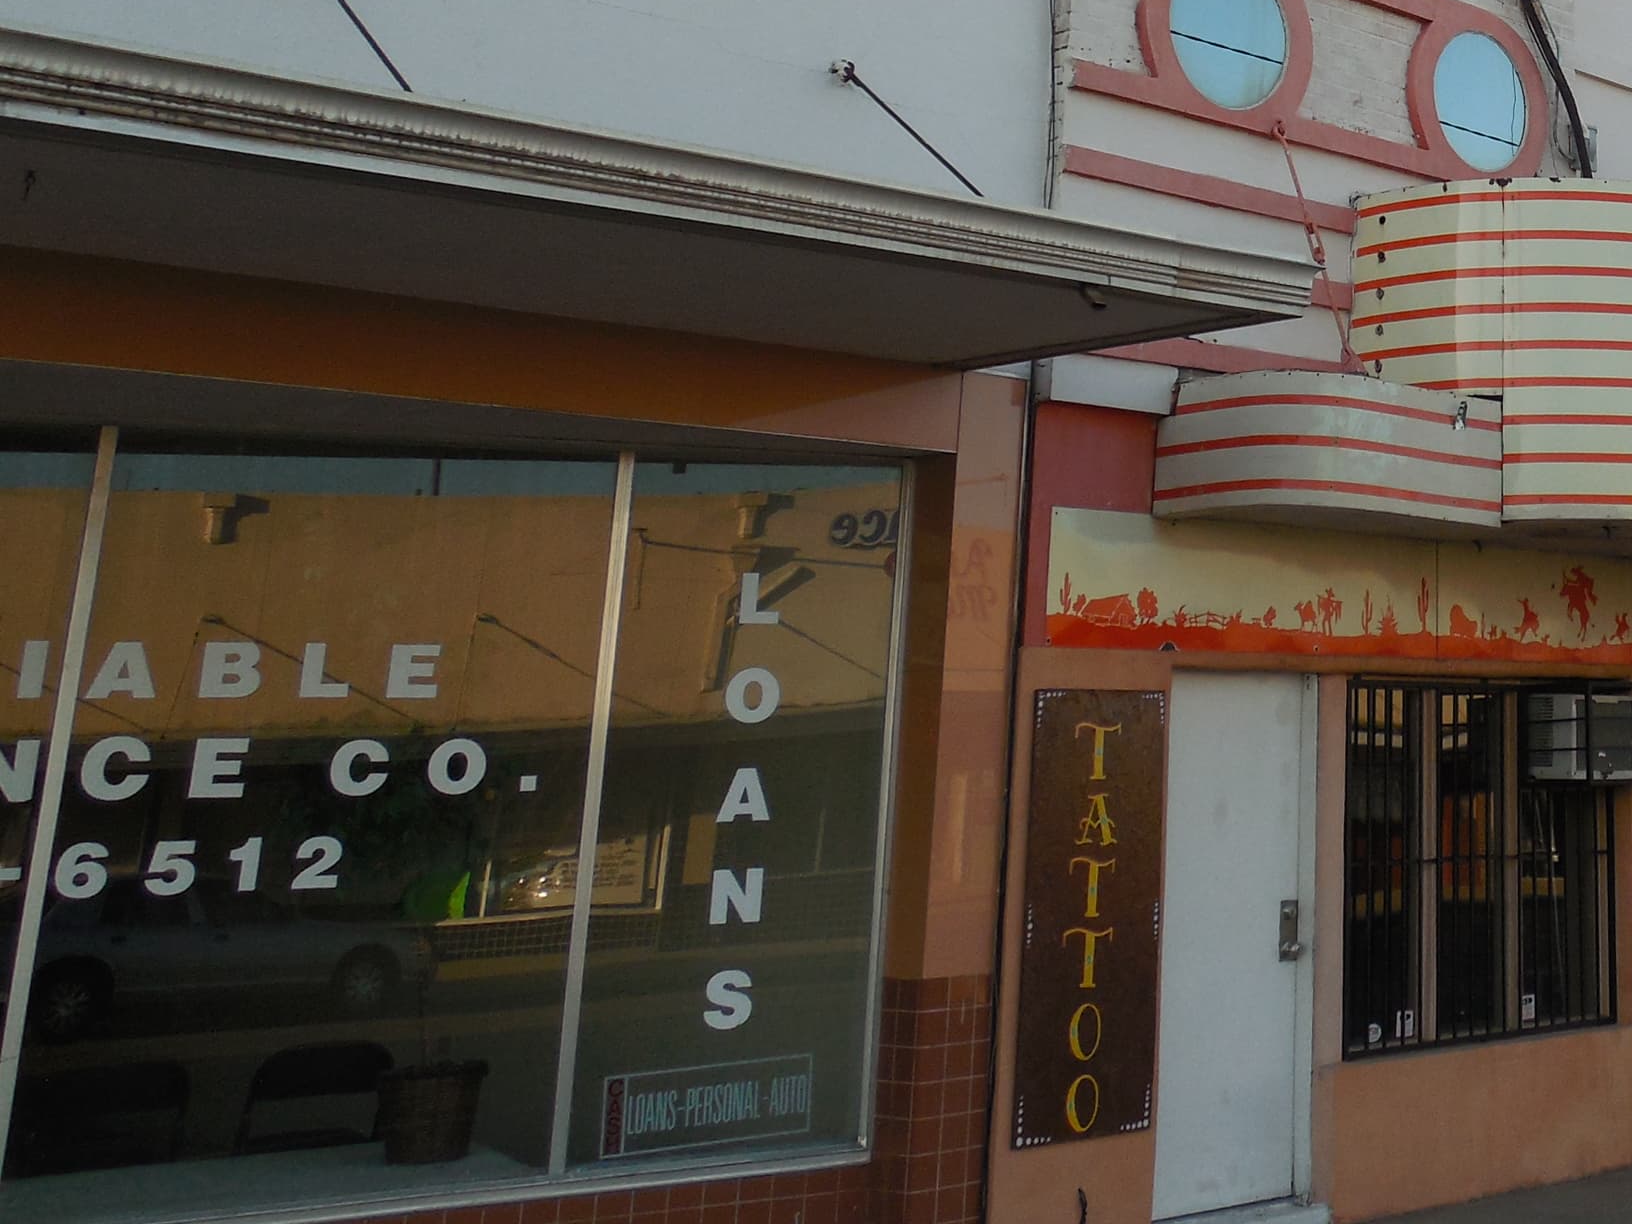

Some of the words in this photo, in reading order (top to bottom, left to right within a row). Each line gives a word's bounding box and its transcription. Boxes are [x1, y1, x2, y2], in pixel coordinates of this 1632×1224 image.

[328, 738, 538, 796] CO.
[702, 572, 780, 1031] LOANS
[1062, 721, 1122, 1134] TATTOO
